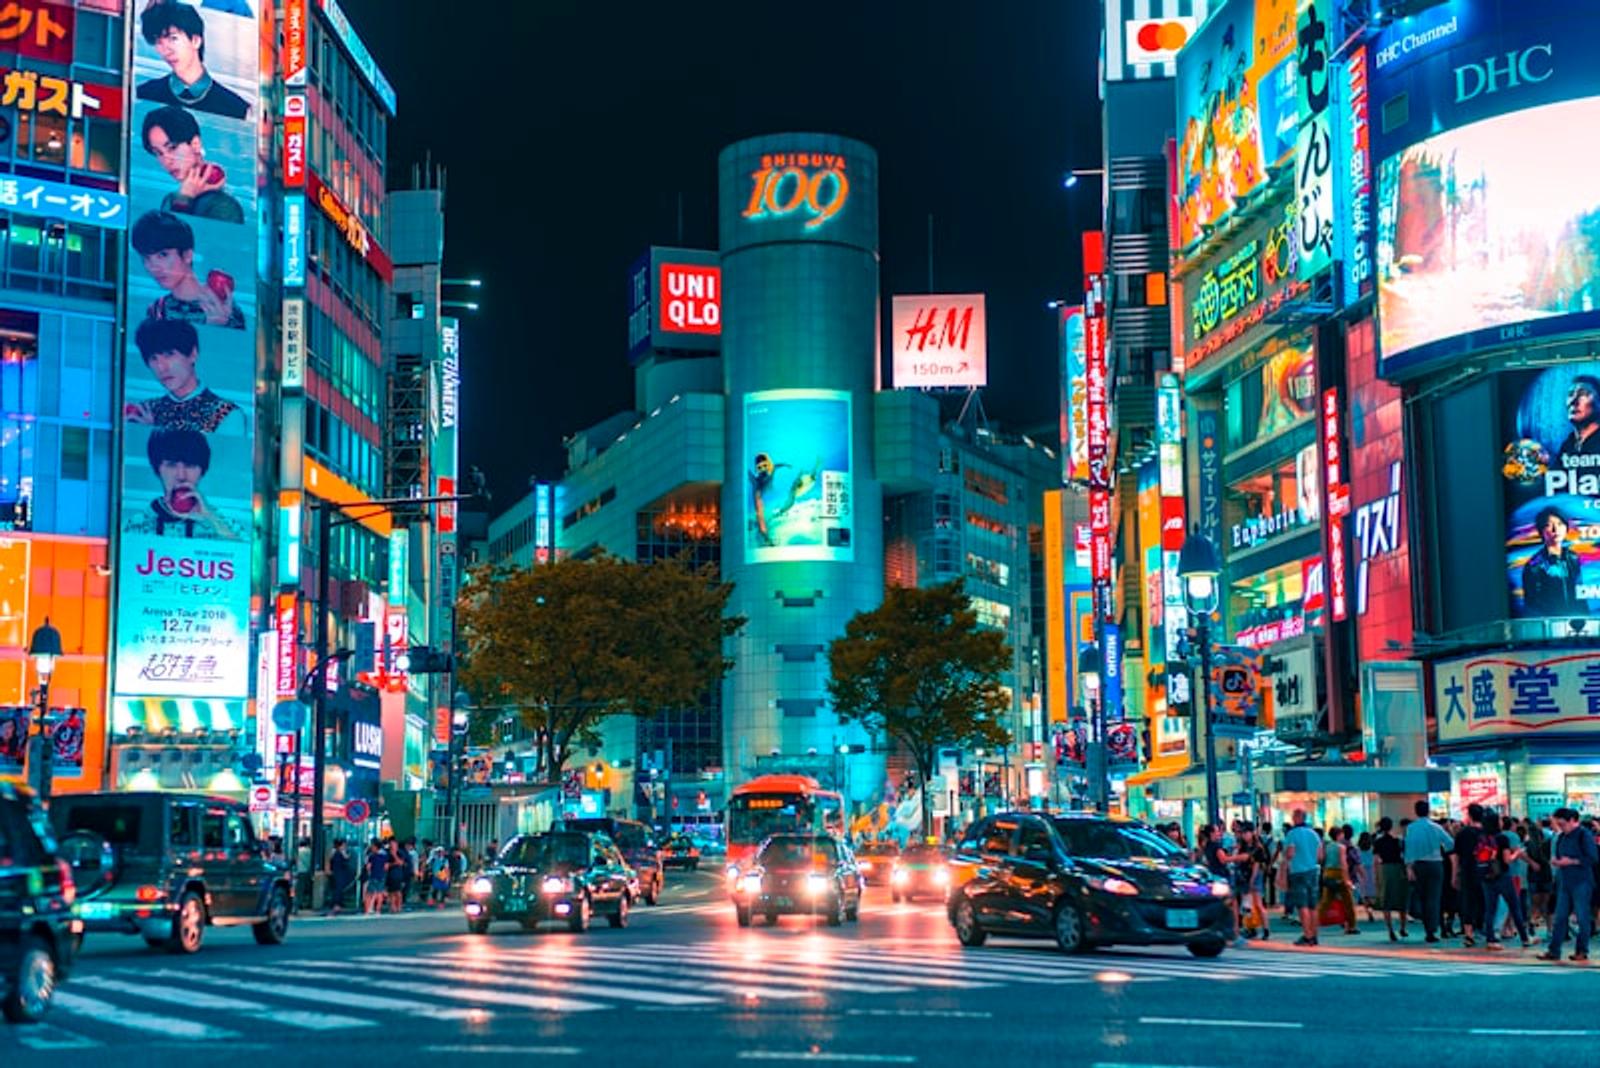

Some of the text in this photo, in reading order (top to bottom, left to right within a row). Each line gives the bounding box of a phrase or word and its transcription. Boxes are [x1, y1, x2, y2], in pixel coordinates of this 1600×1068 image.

[1376, 16, 1458, 69] DHC Channel
[2, 71, 100, 119] ガスト
[1453, 43, 1553, 103] DHC
[1299, 3, 1334, 257] もんじゃ
[761, 153, 846, 169] SHIBUYA
[741, 165, 850, 231] 109
[668, 272, 716, 299] UNI
[668, 300, 719, 328] QLO
[906, 306, 974, 352] H&M
[913, 362, 954, 376] 150m
[1545, 469, 1600, 497] Pla
[1356, 462, 1401, 615] クスリ
[136, 548, 235, 581] Jesus
[1105, 633, 1118, 677] MIZUHO
[355, 721, 382, 758] LUSH
